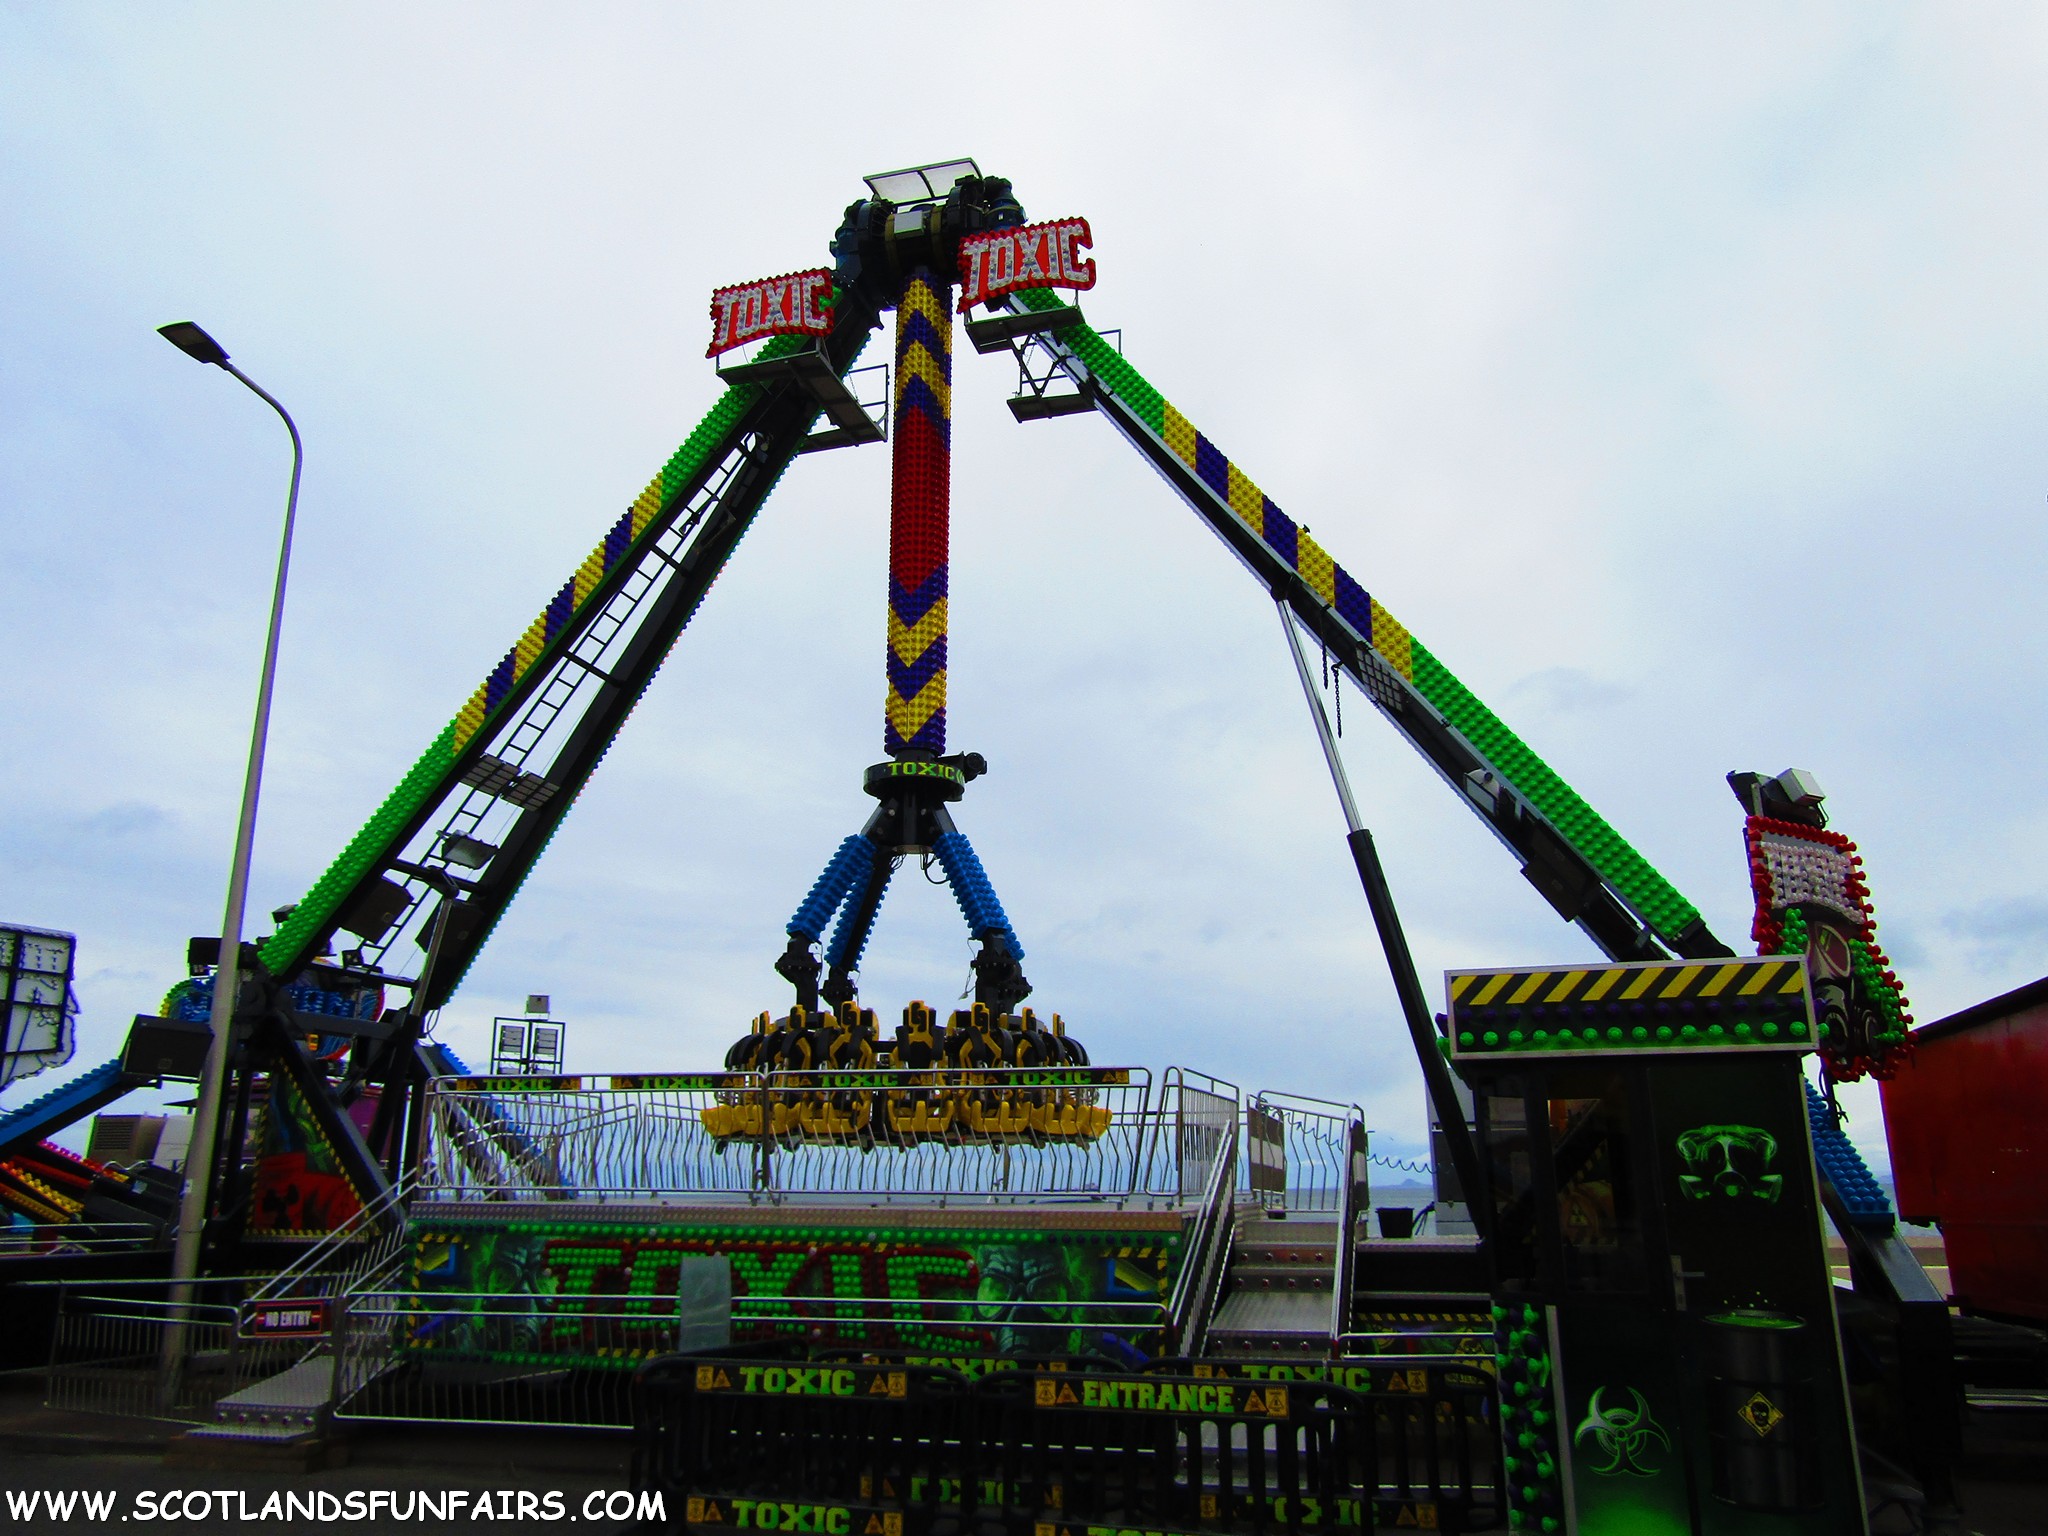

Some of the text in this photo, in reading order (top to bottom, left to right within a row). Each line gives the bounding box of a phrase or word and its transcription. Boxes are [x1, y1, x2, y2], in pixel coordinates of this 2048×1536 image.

[963, 222, 1091, 299] TOXIC
[714, 274, 830, 347] TOXIC
[888, 761, 956, 780] TOXIC
[483, 1078, 554, 1092] TOXIC
[639, 1075, 714, 1090] TOXIC
[817, 1073, 900, 1088] TOXIC
[1005, 1070, 1093, 1085] TOXIC
[265, 1310, 312, 1328] NO ENTRY
[739, 1366, 856, 1396] TOXIC
[1082, 1380, 1235, 1413] ENTRANCE
[731, 1499, 852, 1535] TOXIC
[1245, 1495, 1380, 1527] OXIC
